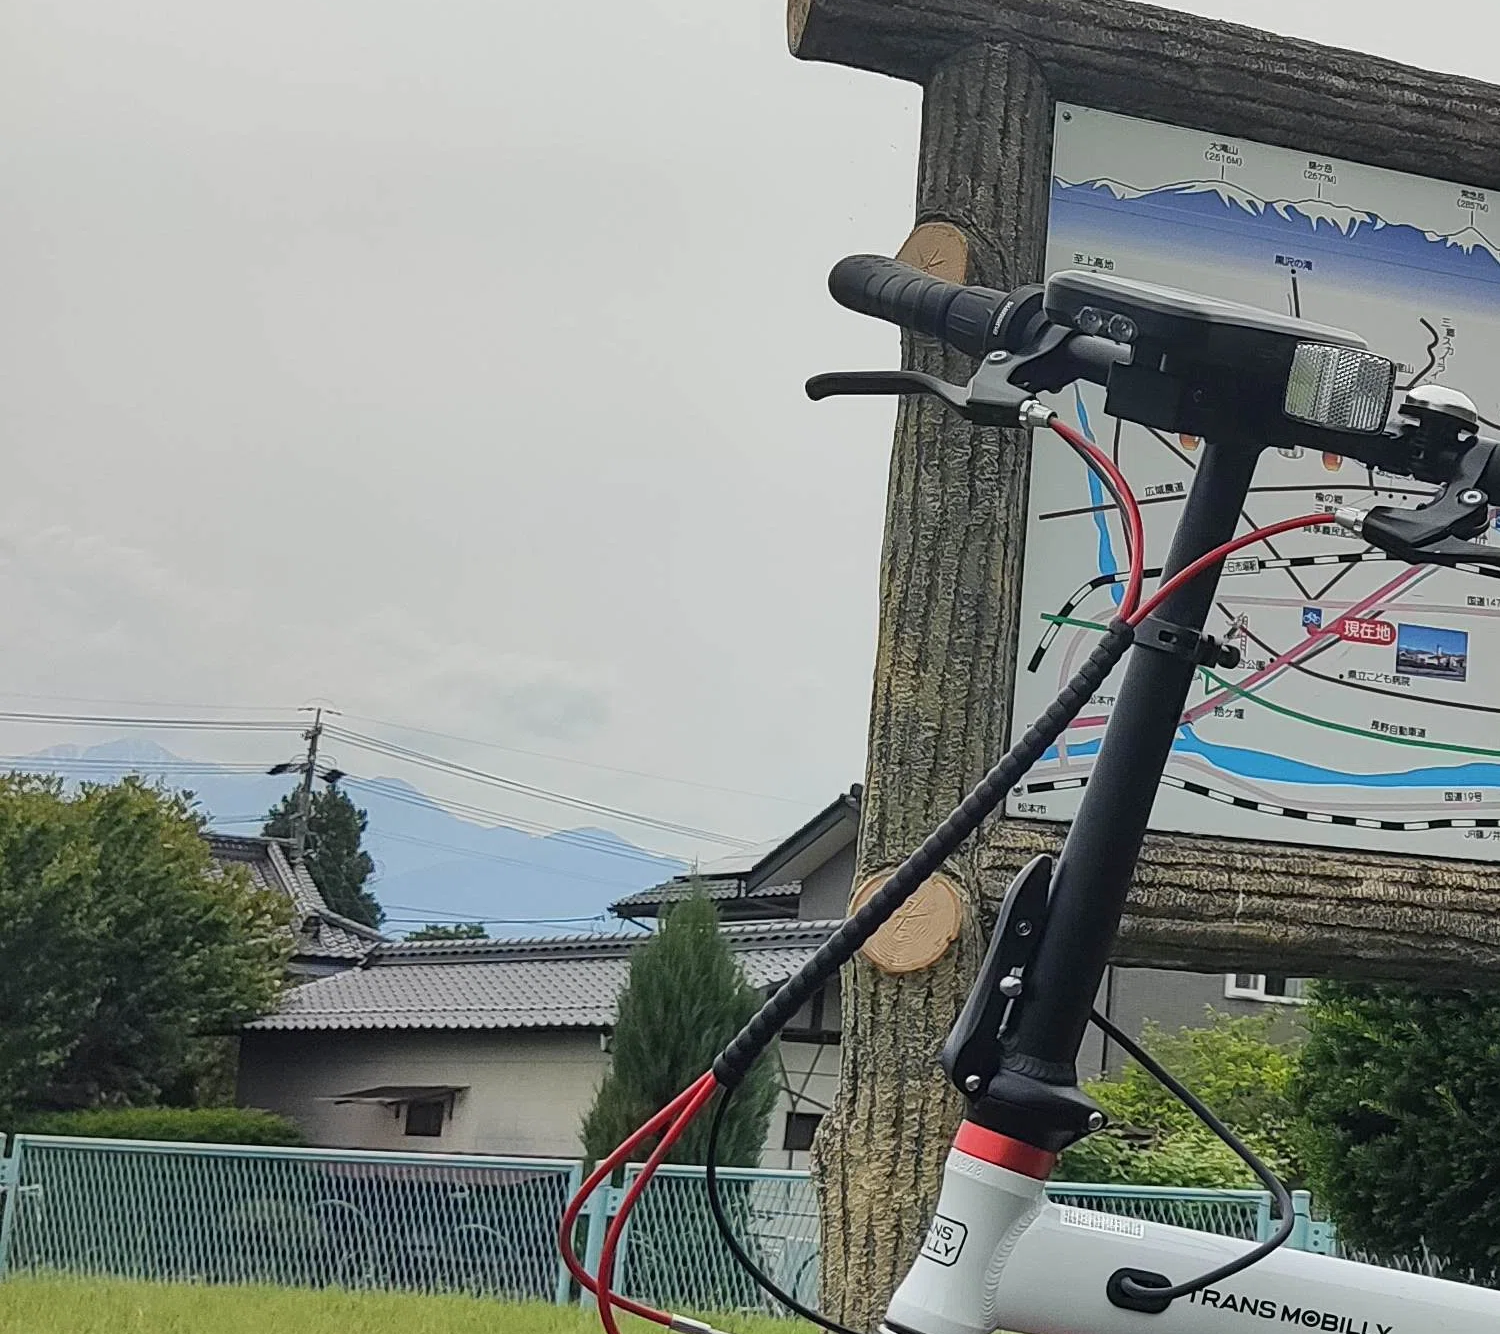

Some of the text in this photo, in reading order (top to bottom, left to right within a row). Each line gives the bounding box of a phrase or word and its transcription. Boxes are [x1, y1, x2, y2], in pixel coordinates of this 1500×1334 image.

[1073, 253, 1114, 270] 至上高地
[1344, 622, 1391, 640] 現在地
[1347, 670, 1411, 687] 県立こども病院
[1371, 720, 1427, 738] 長野自動車道
[1444, 791, 1483, 803] 国道19号
[1018, 802, 1047, 815] 松本市
[1187, 1287, 1277, 1320] TRANS
